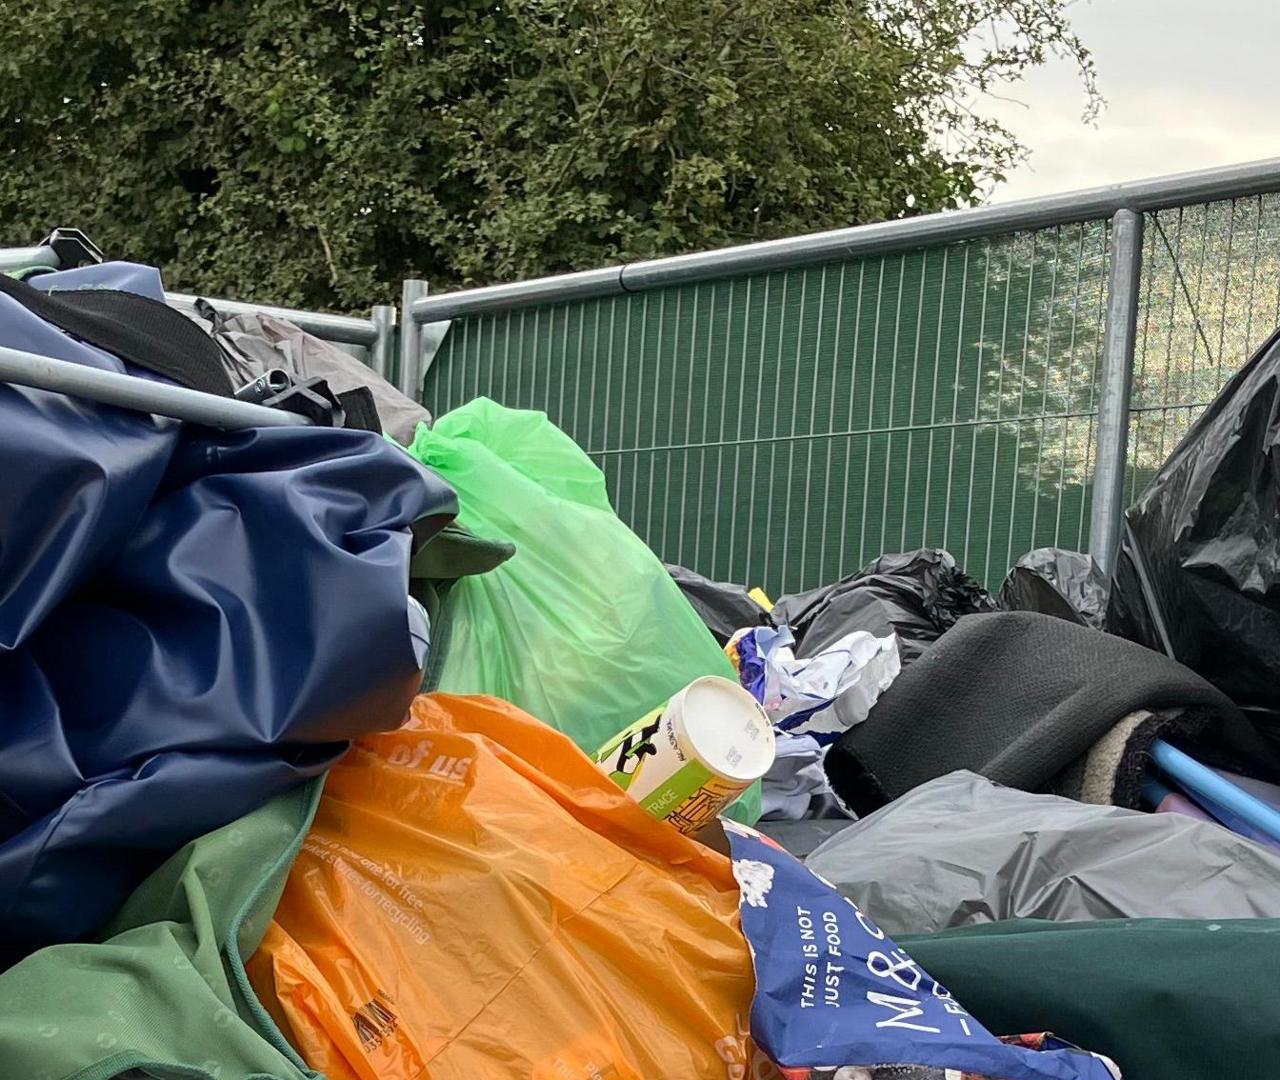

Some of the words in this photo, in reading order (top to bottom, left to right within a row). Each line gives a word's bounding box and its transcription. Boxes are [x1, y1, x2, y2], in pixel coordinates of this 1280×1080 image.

[387, 739, 433, 768] of
[430, 754, 472, 781] us
[646, 789, 679, 816] TRACE
[797, 906, 815, 940] NOT
[823, 912, 841, 957] FOOD
[803, 945, 818, 958] IS
[801, 963, 817, 1008] THIS
[824, 961, 845, 1008] JUST
